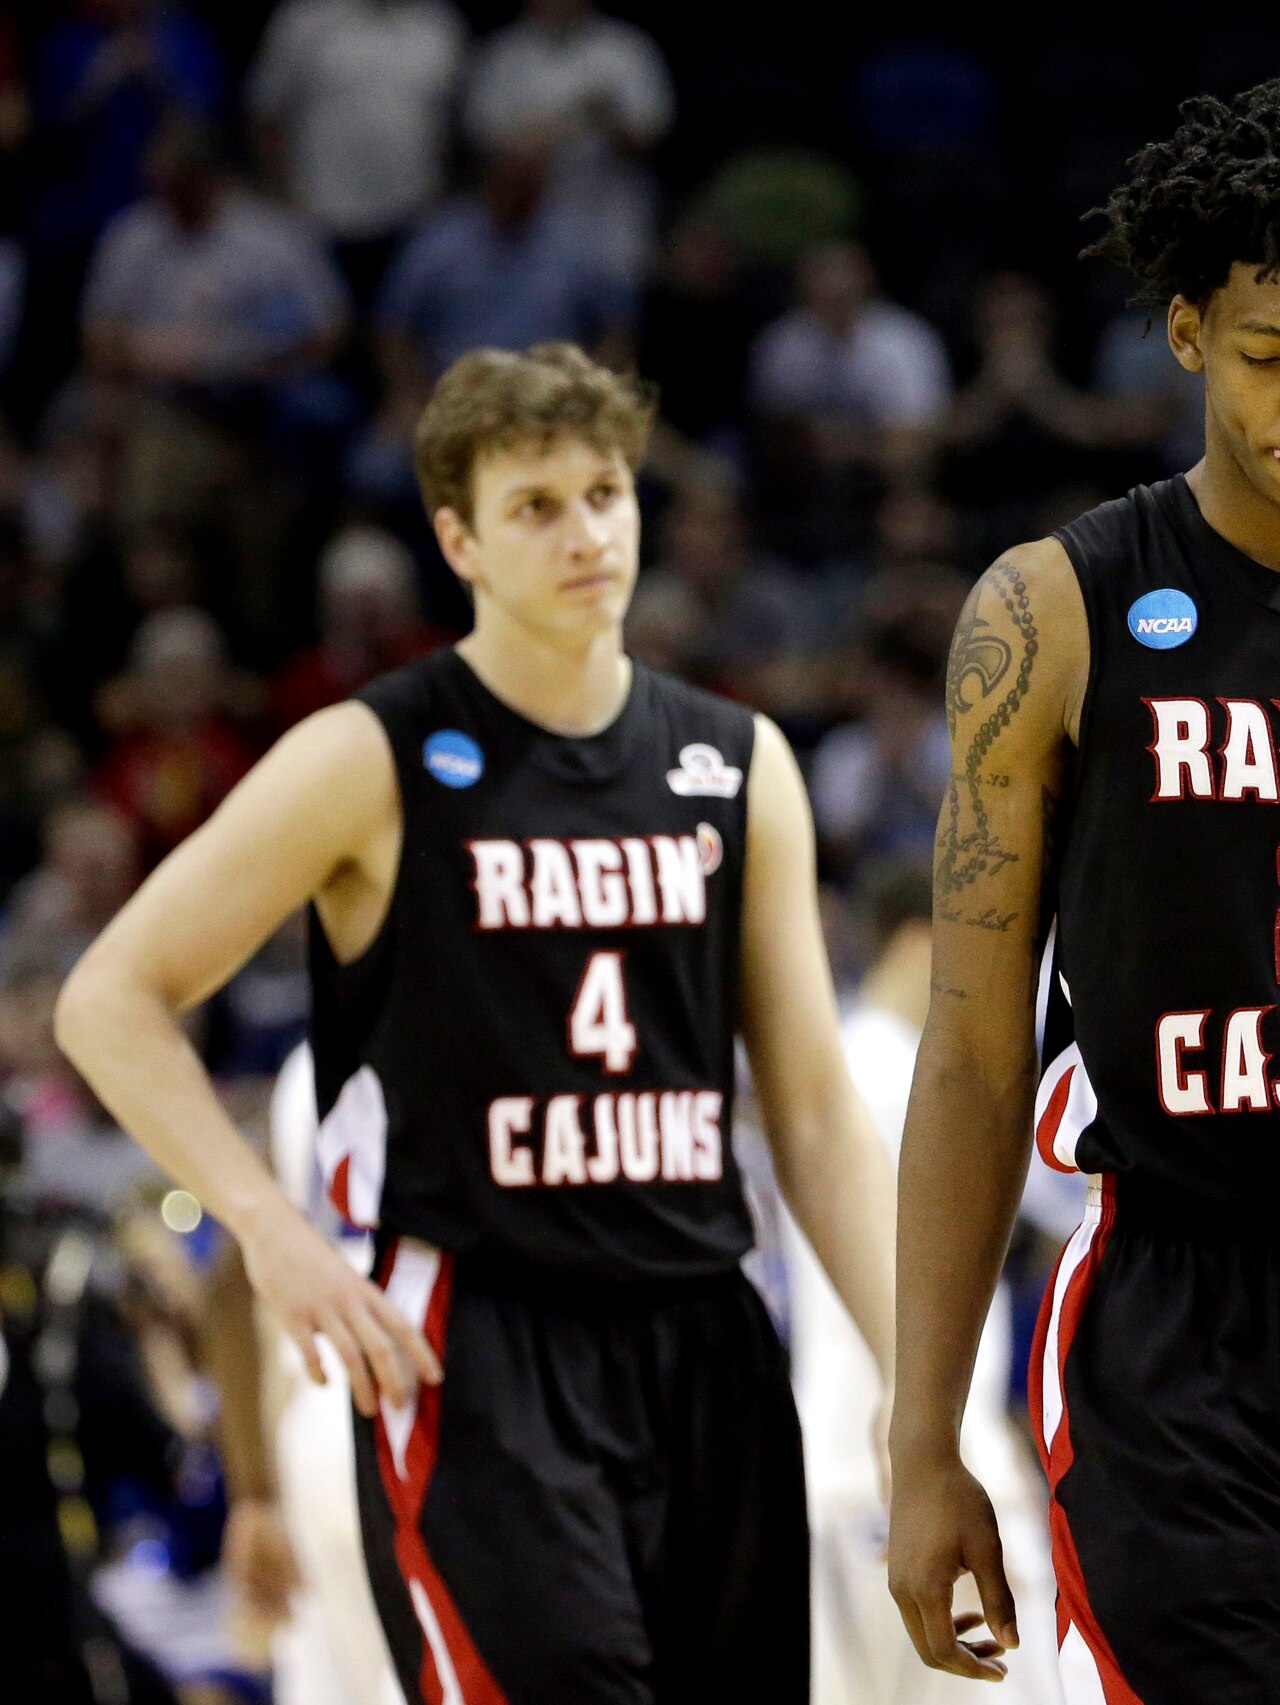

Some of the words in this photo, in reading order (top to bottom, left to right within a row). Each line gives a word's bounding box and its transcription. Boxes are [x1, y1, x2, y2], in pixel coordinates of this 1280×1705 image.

[1137, 617, 1193, 634] NCAA
[567, 949, 637, 1075] 4
[486, 1089, 723, 1188] CAJUNS
